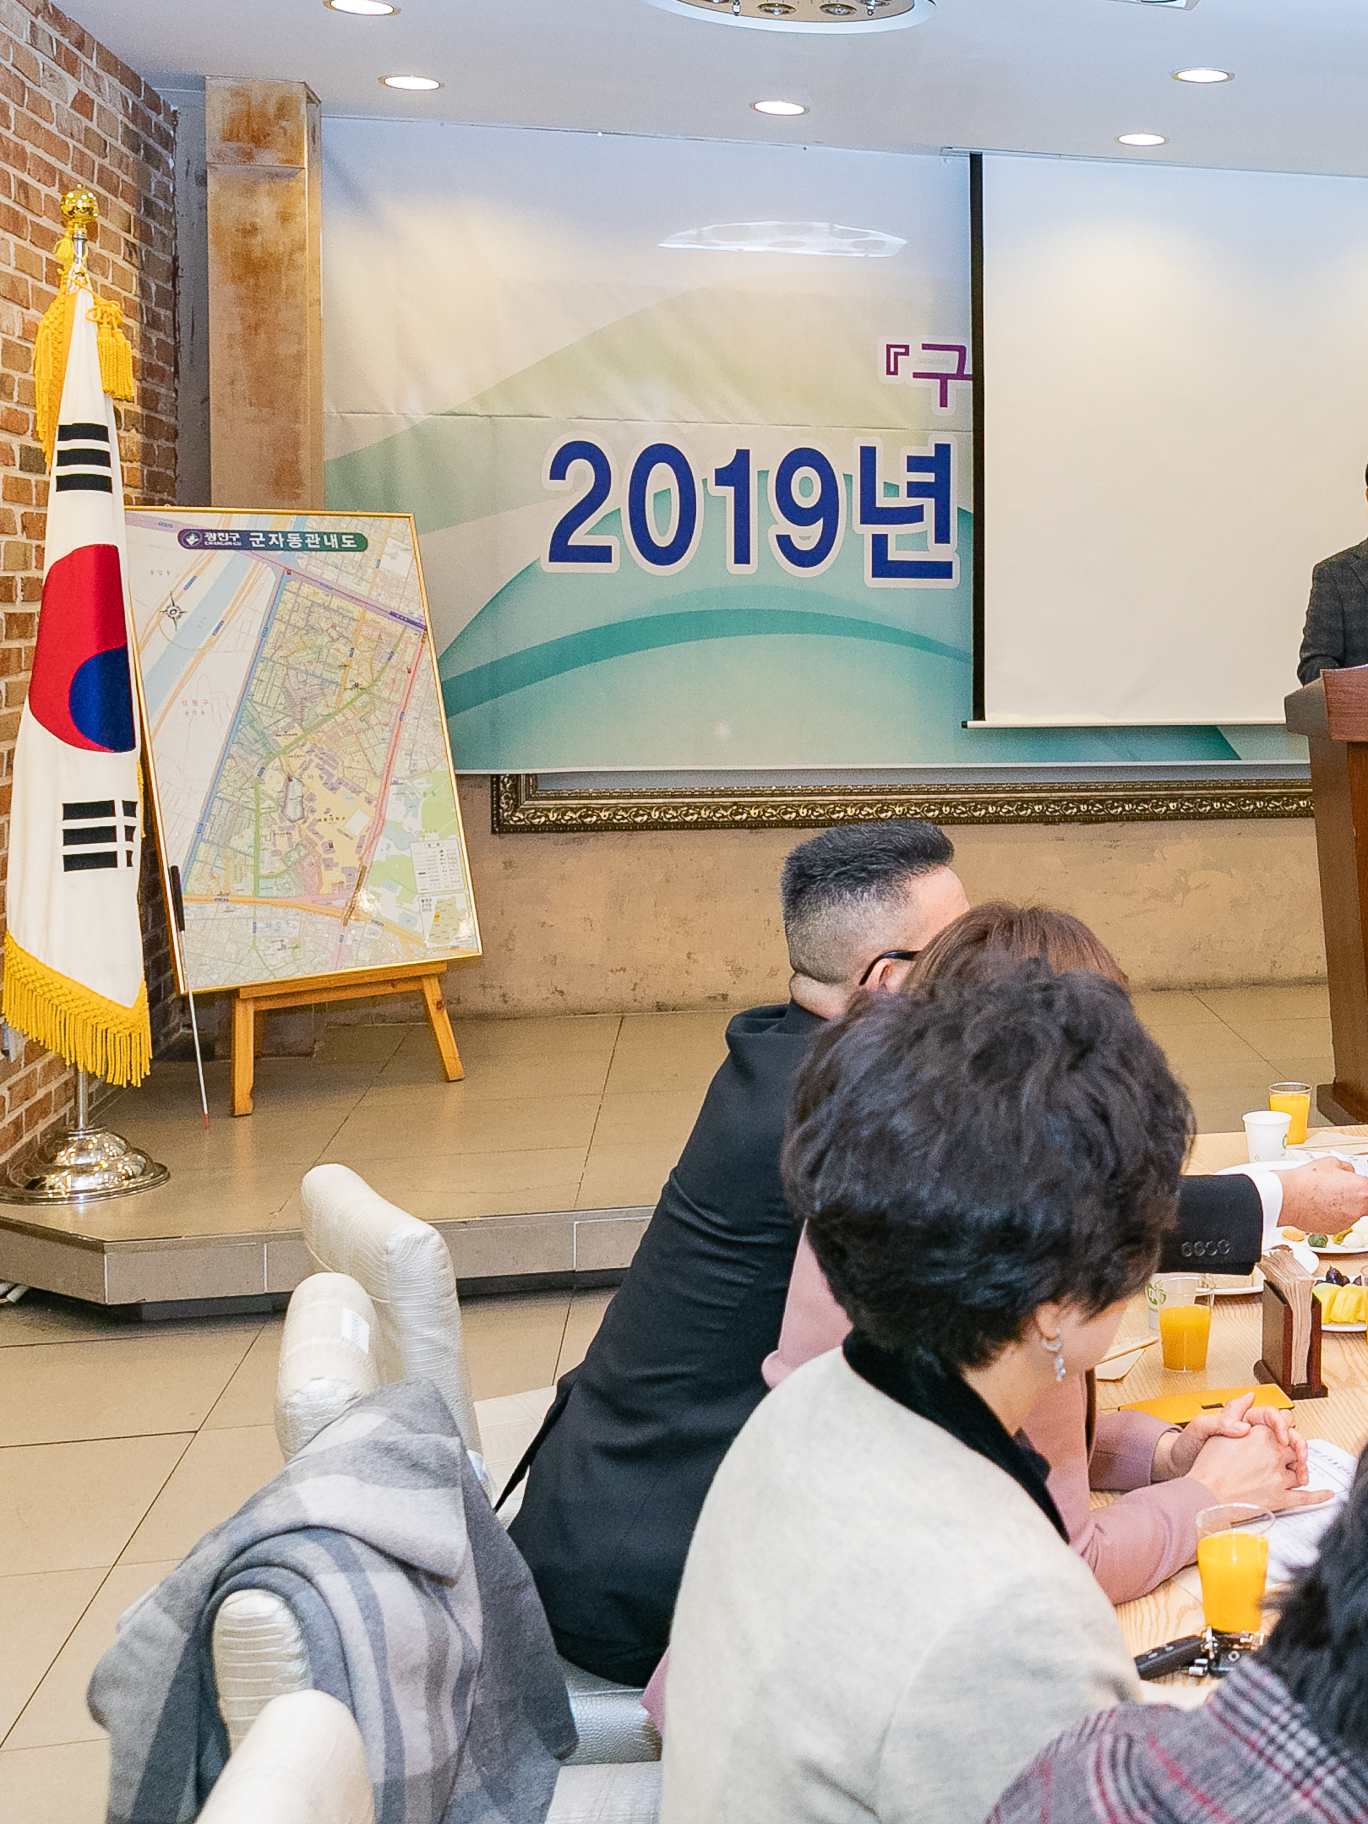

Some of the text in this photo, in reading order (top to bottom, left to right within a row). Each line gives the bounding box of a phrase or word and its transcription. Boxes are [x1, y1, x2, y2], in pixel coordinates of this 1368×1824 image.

[204, 532, 358, 549] 광진구 군자동관내도
[547, 440, 954, 580] 2019년
